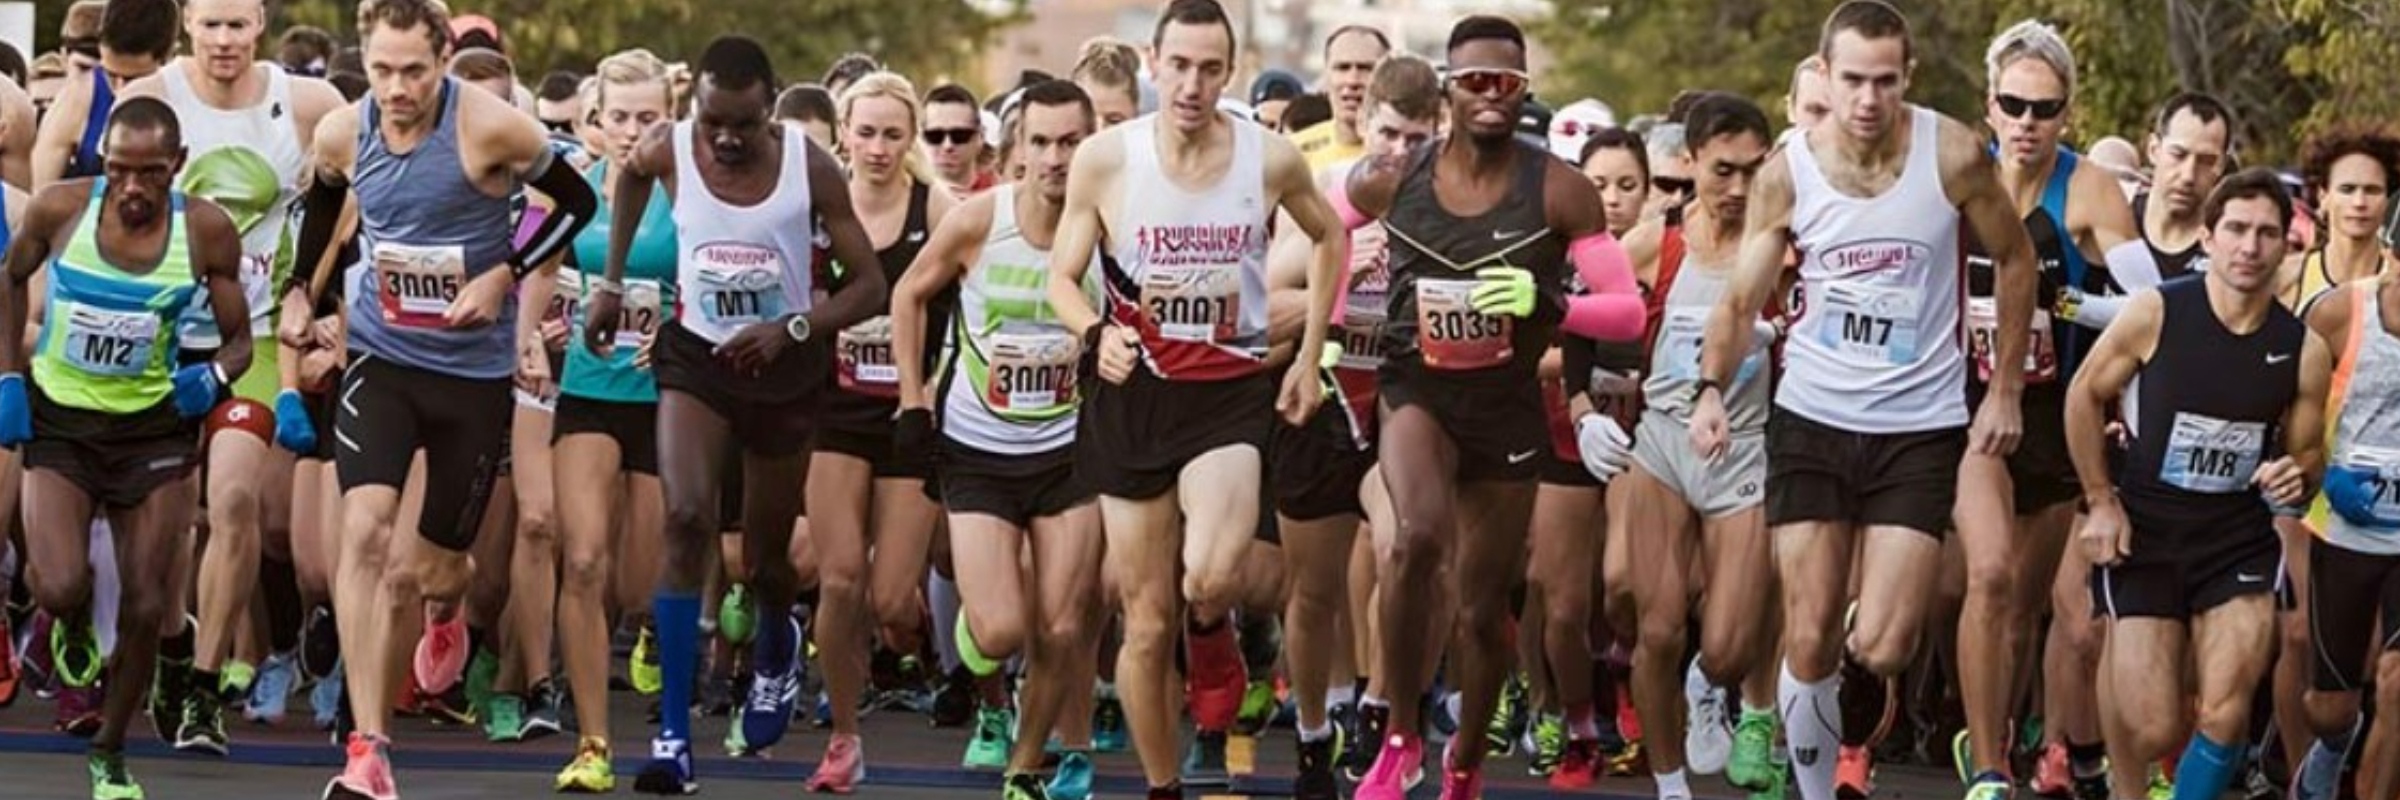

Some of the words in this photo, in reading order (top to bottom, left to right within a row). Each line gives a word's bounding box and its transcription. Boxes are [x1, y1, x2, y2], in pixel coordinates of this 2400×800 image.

[715, 291, 760, 316] M1
[1149, 296, 1226, 325] 3001
[1843, 312, 1893, 346] M7
[84, 333, 134, 366] M2
[2188, 447, 2238, 477] M8
